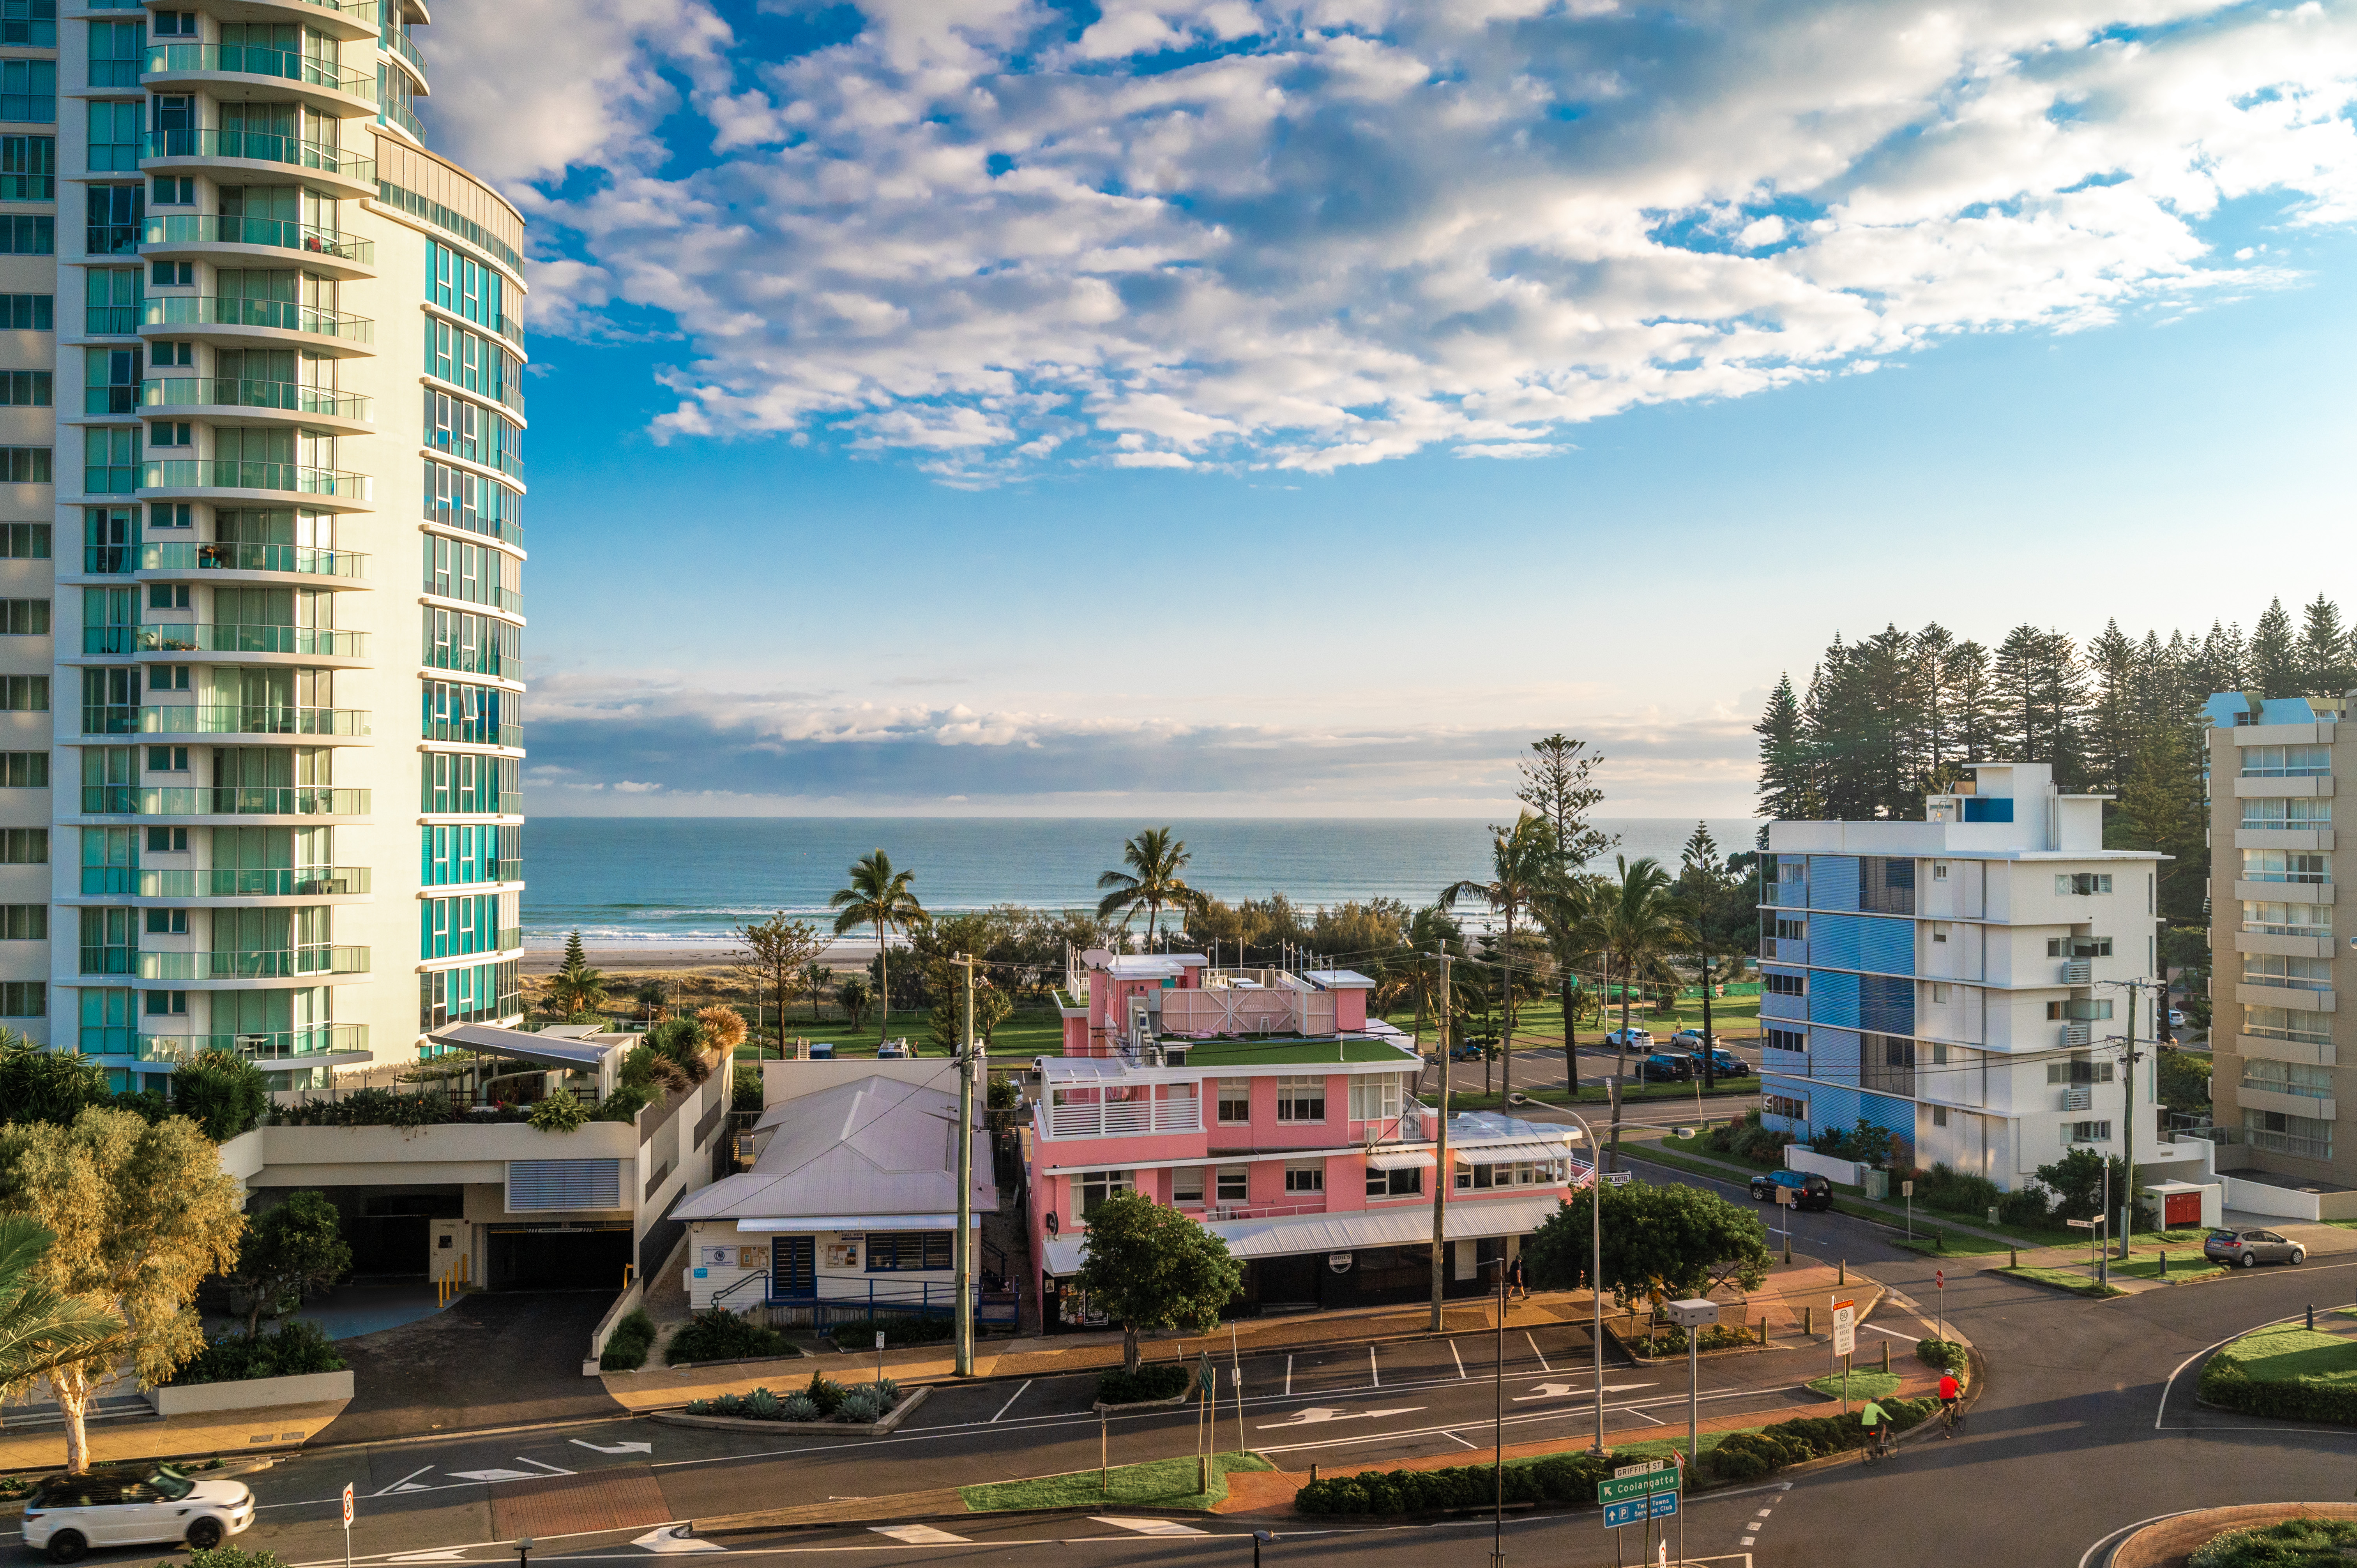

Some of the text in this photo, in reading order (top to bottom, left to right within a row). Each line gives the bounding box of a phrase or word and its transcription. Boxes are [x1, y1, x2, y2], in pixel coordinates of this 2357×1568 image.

[1839, 1321, 1853, 1330] BUILT-UP
[1618, 1476, 1674, 1493] Coolangatta
[1621, 1509, 1626, 1518] P
